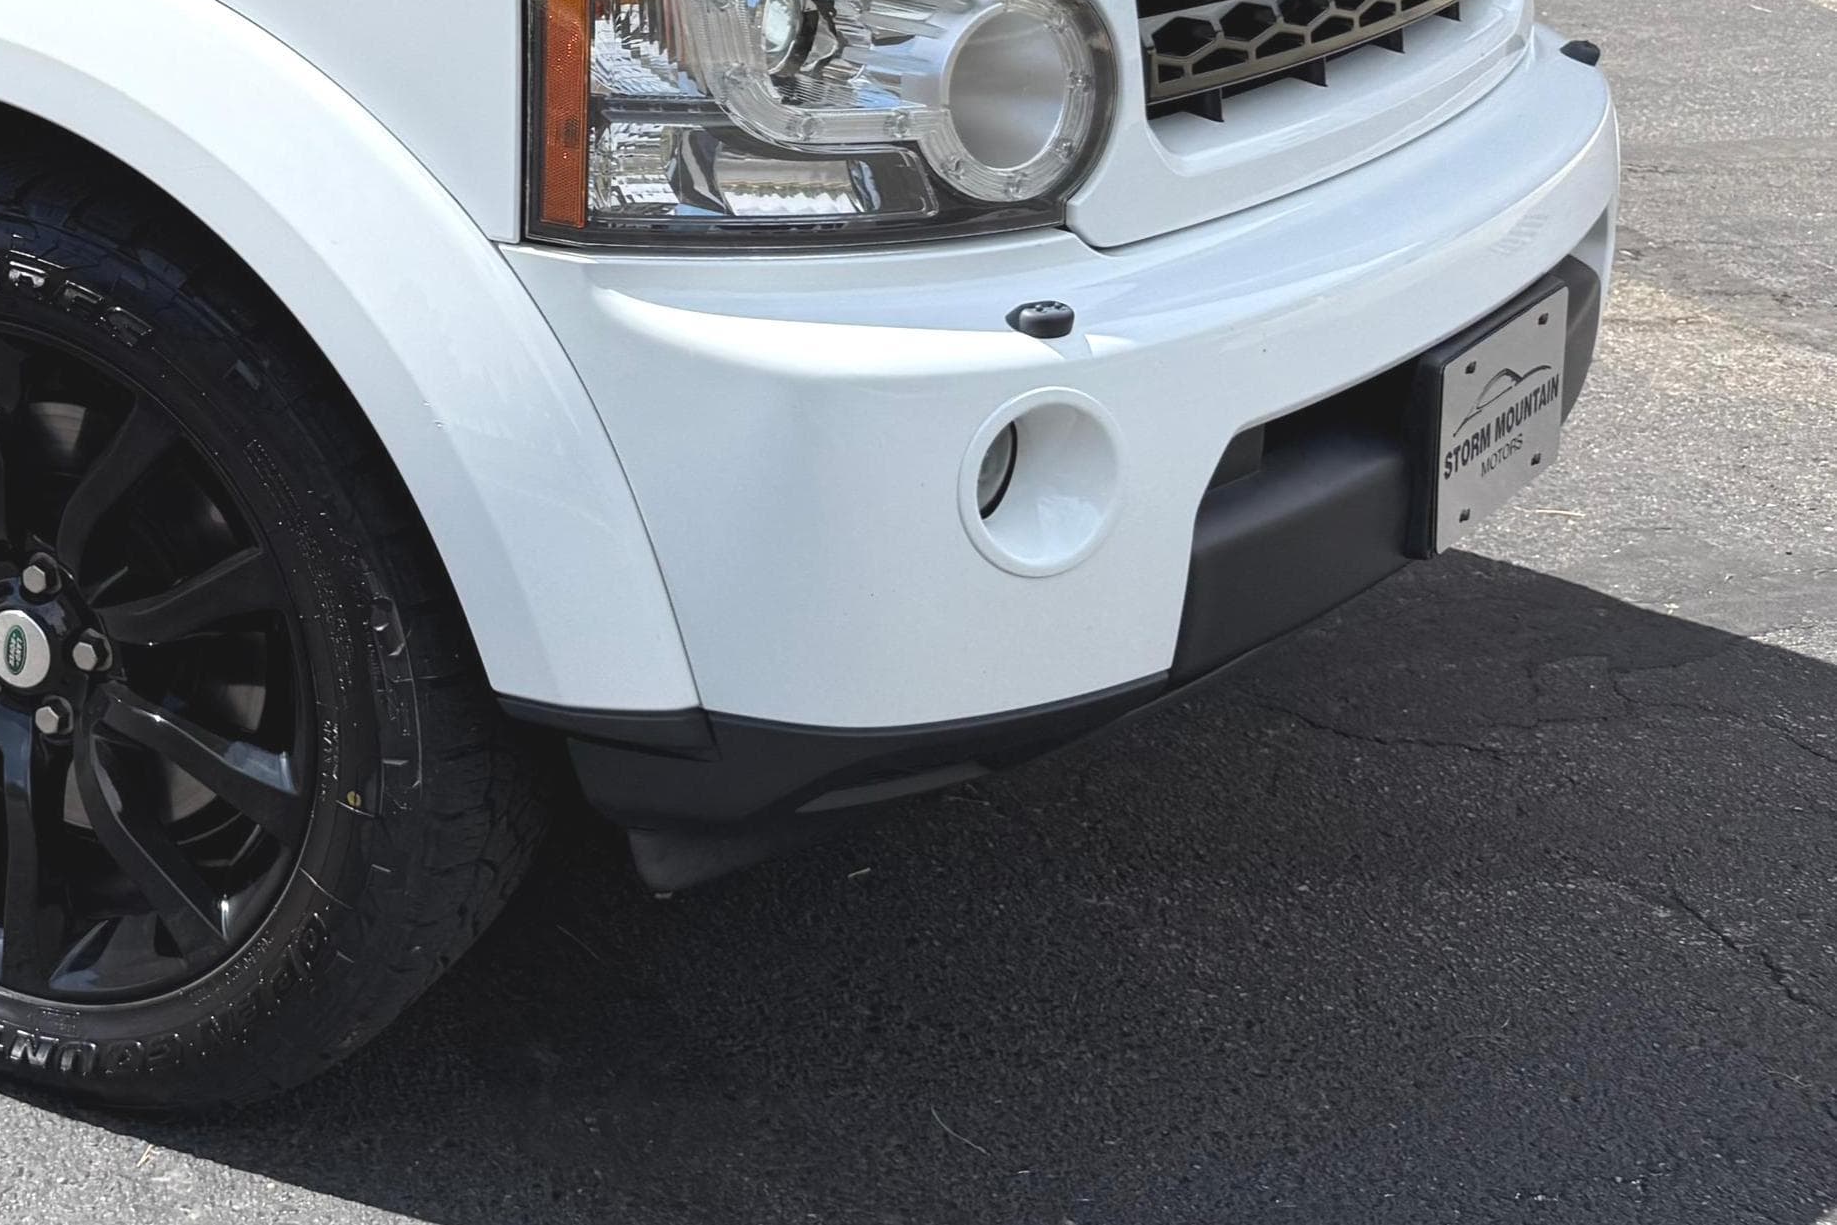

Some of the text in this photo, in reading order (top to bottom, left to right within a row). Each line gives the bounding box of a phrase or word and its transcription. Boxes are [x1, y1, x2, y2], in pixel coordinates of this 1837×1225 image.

[1443, 373, 1559, 481] STORM MOUNTAIN
[1480, 432, 1524, 478] MOTORS
